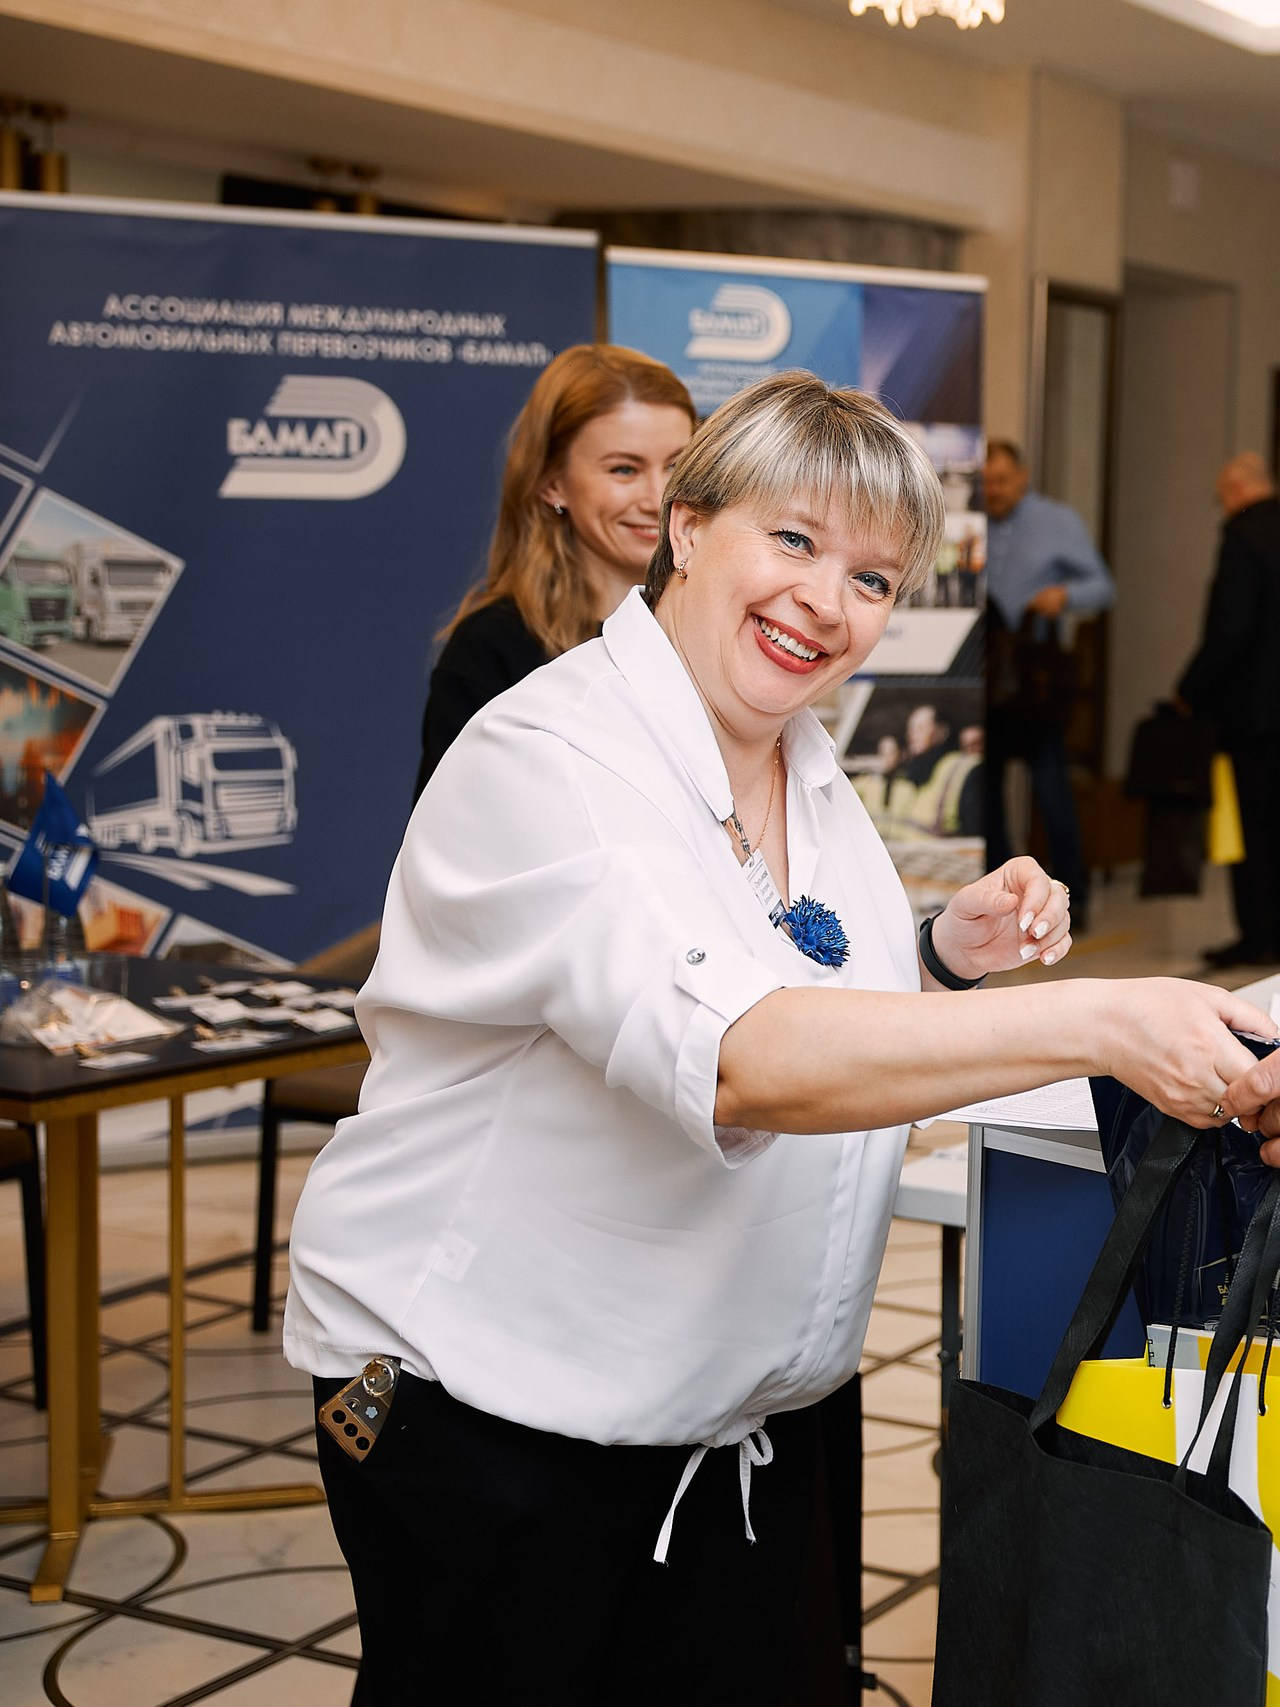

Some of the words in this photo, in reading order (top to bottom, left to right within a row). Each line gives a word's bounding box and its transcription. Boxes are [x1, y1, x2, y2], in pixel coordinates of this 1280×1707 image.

[103, 293, 284, 326] АССОЦИАЦИЯ
[286, 302, 506, 338] МЕЖДУНАРОДНЫХ
[48, 320, 274, 355] АВТОМОБИЛЬНЫХ
[276, 330, 452, 364] ПЕРЕВОЗЧИКОВ
[227, 418, 361, 458] БАМАП
